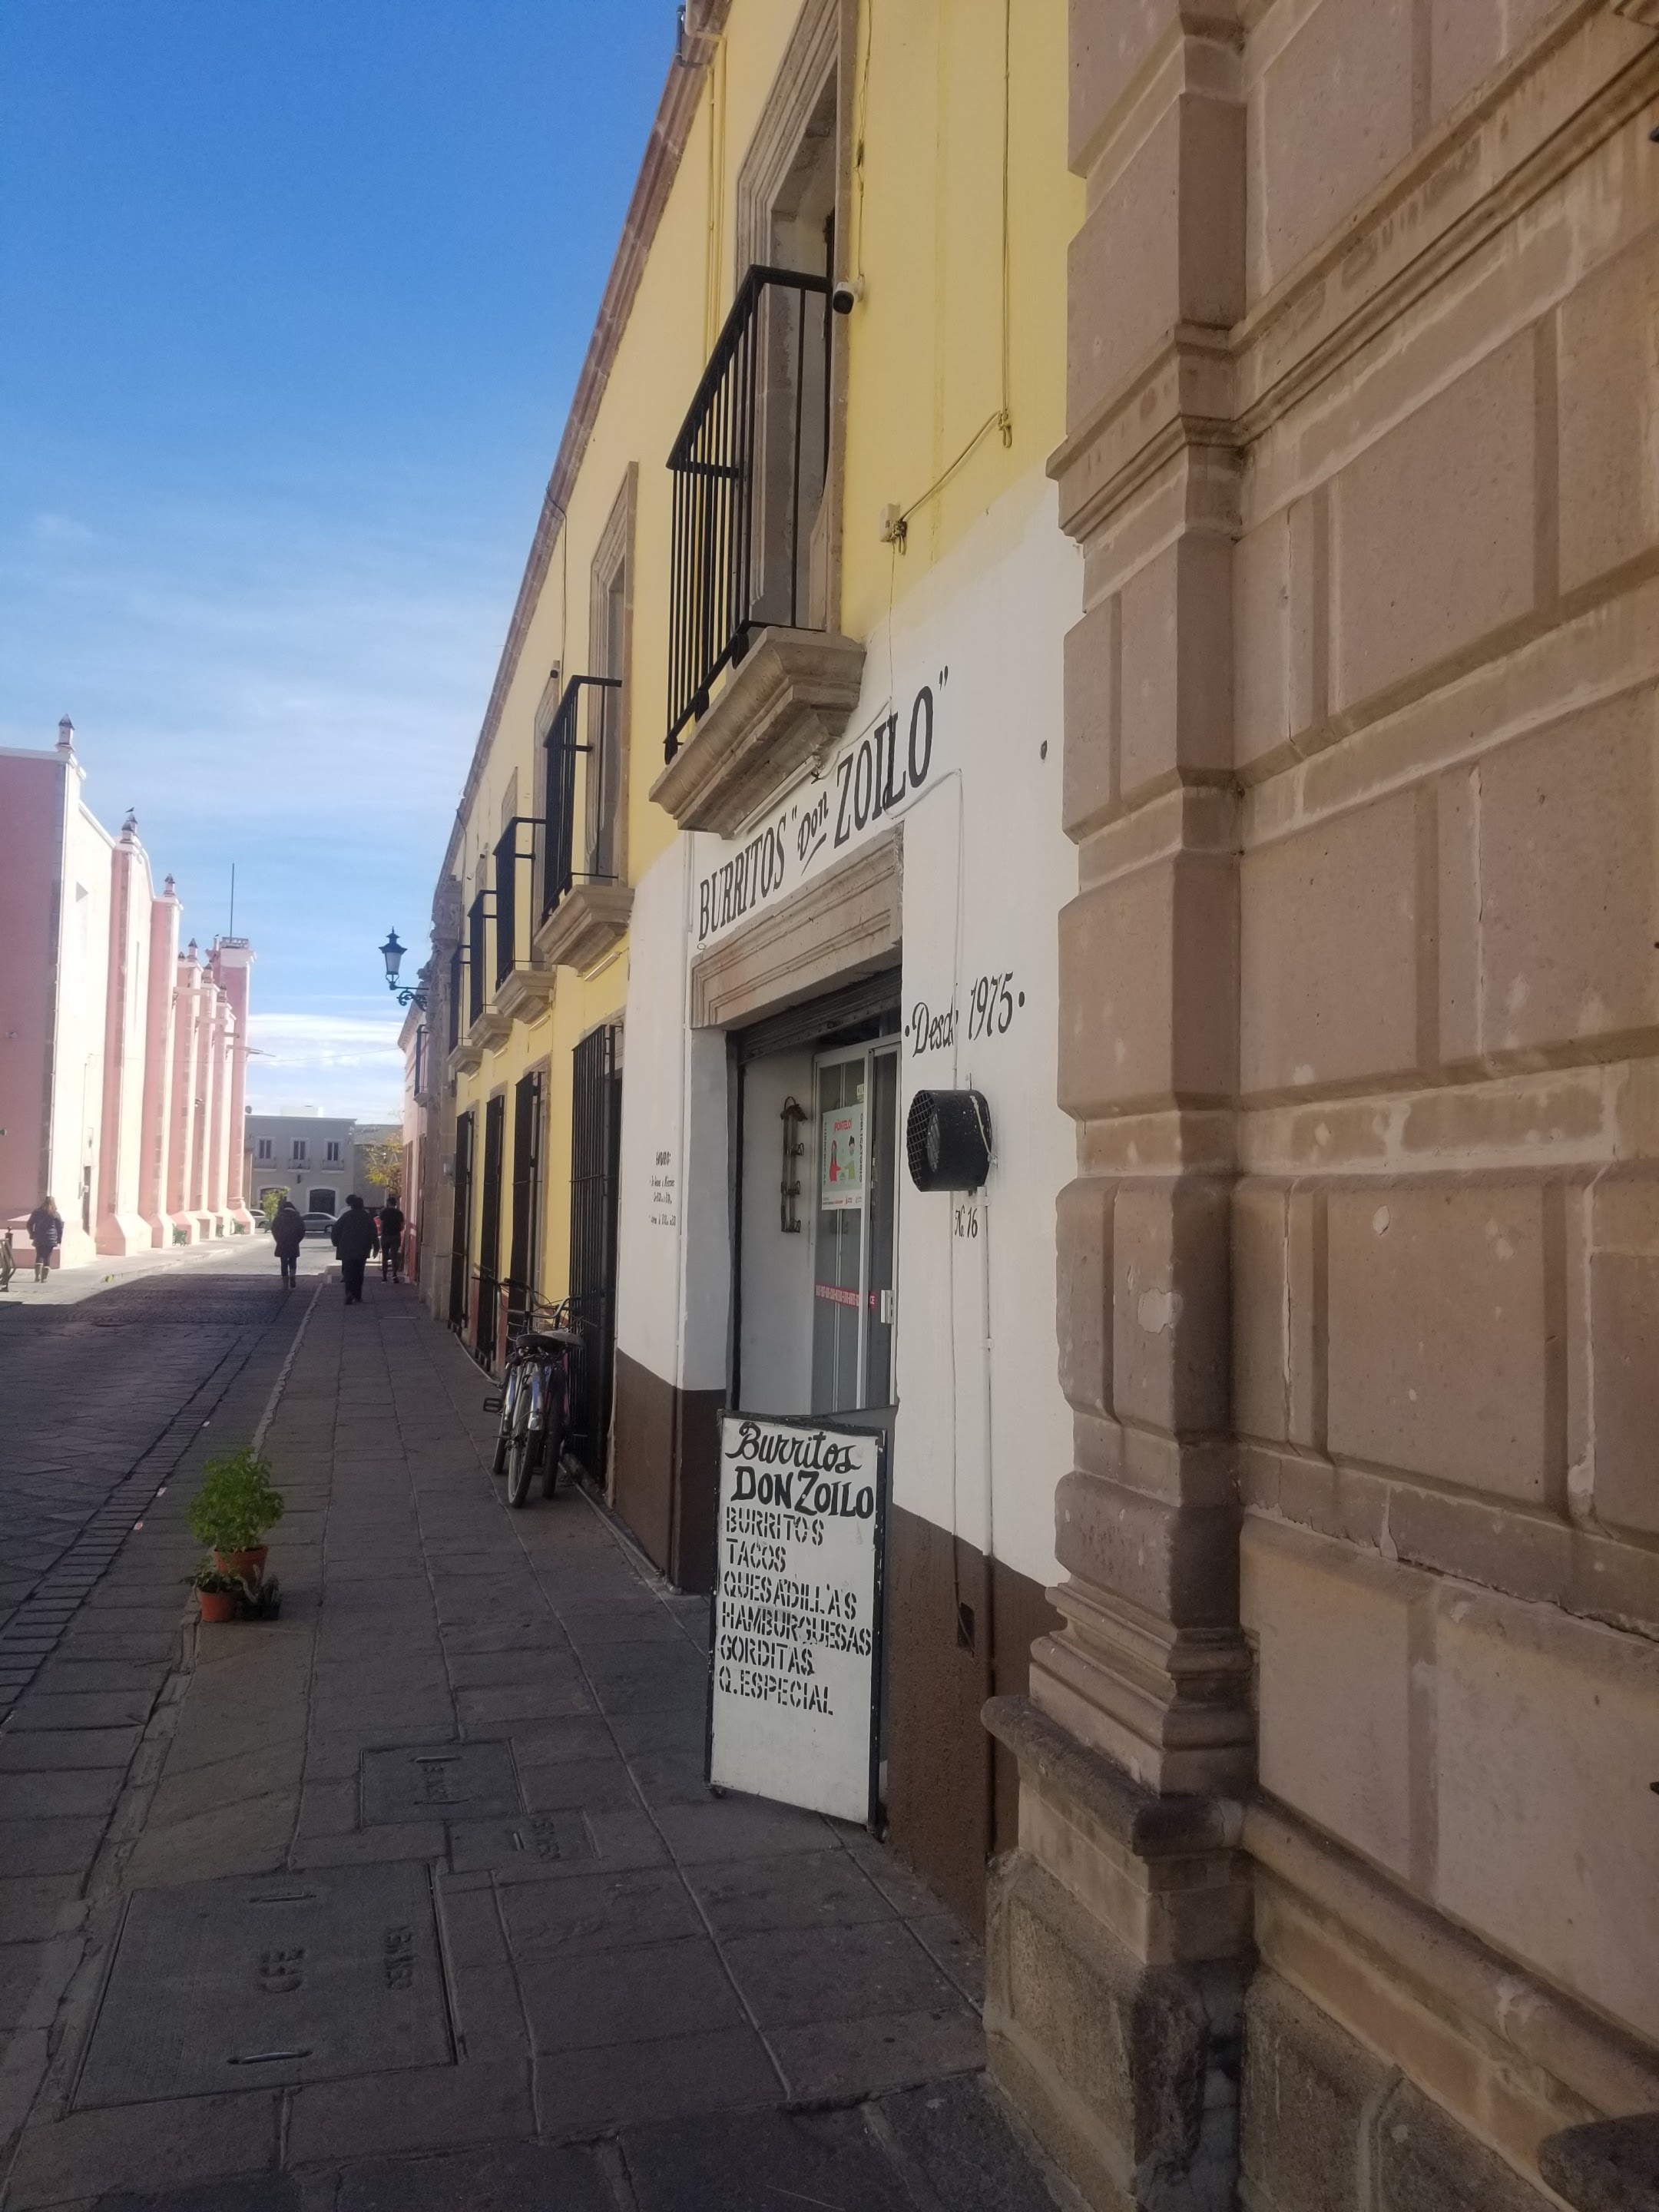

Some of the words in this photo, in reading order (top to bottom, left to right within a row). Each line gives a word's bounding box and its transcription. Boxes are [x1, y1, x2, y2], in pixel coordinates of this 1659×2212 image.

[699, 813, 786, 942] BURRITOS
[969, 971, 1013, 1041] 1975
[967, 1207, 979, 1239] 16
[725, 1421, 863, 1474] Burritos
[730, 1465, 794, 1509] DON
[793, 1469, 874, 1519] ZOILO
[726, 1506, 824, 1546] BURRITOS
[726, 1538, 786, 1573] TACOS
[724, 1570, 858, 1621] QUESADILLAS
[722, 1601, 872, 1657] HAMBURGUESAS
[720, 1634, 815, 1677] GORDITAS
